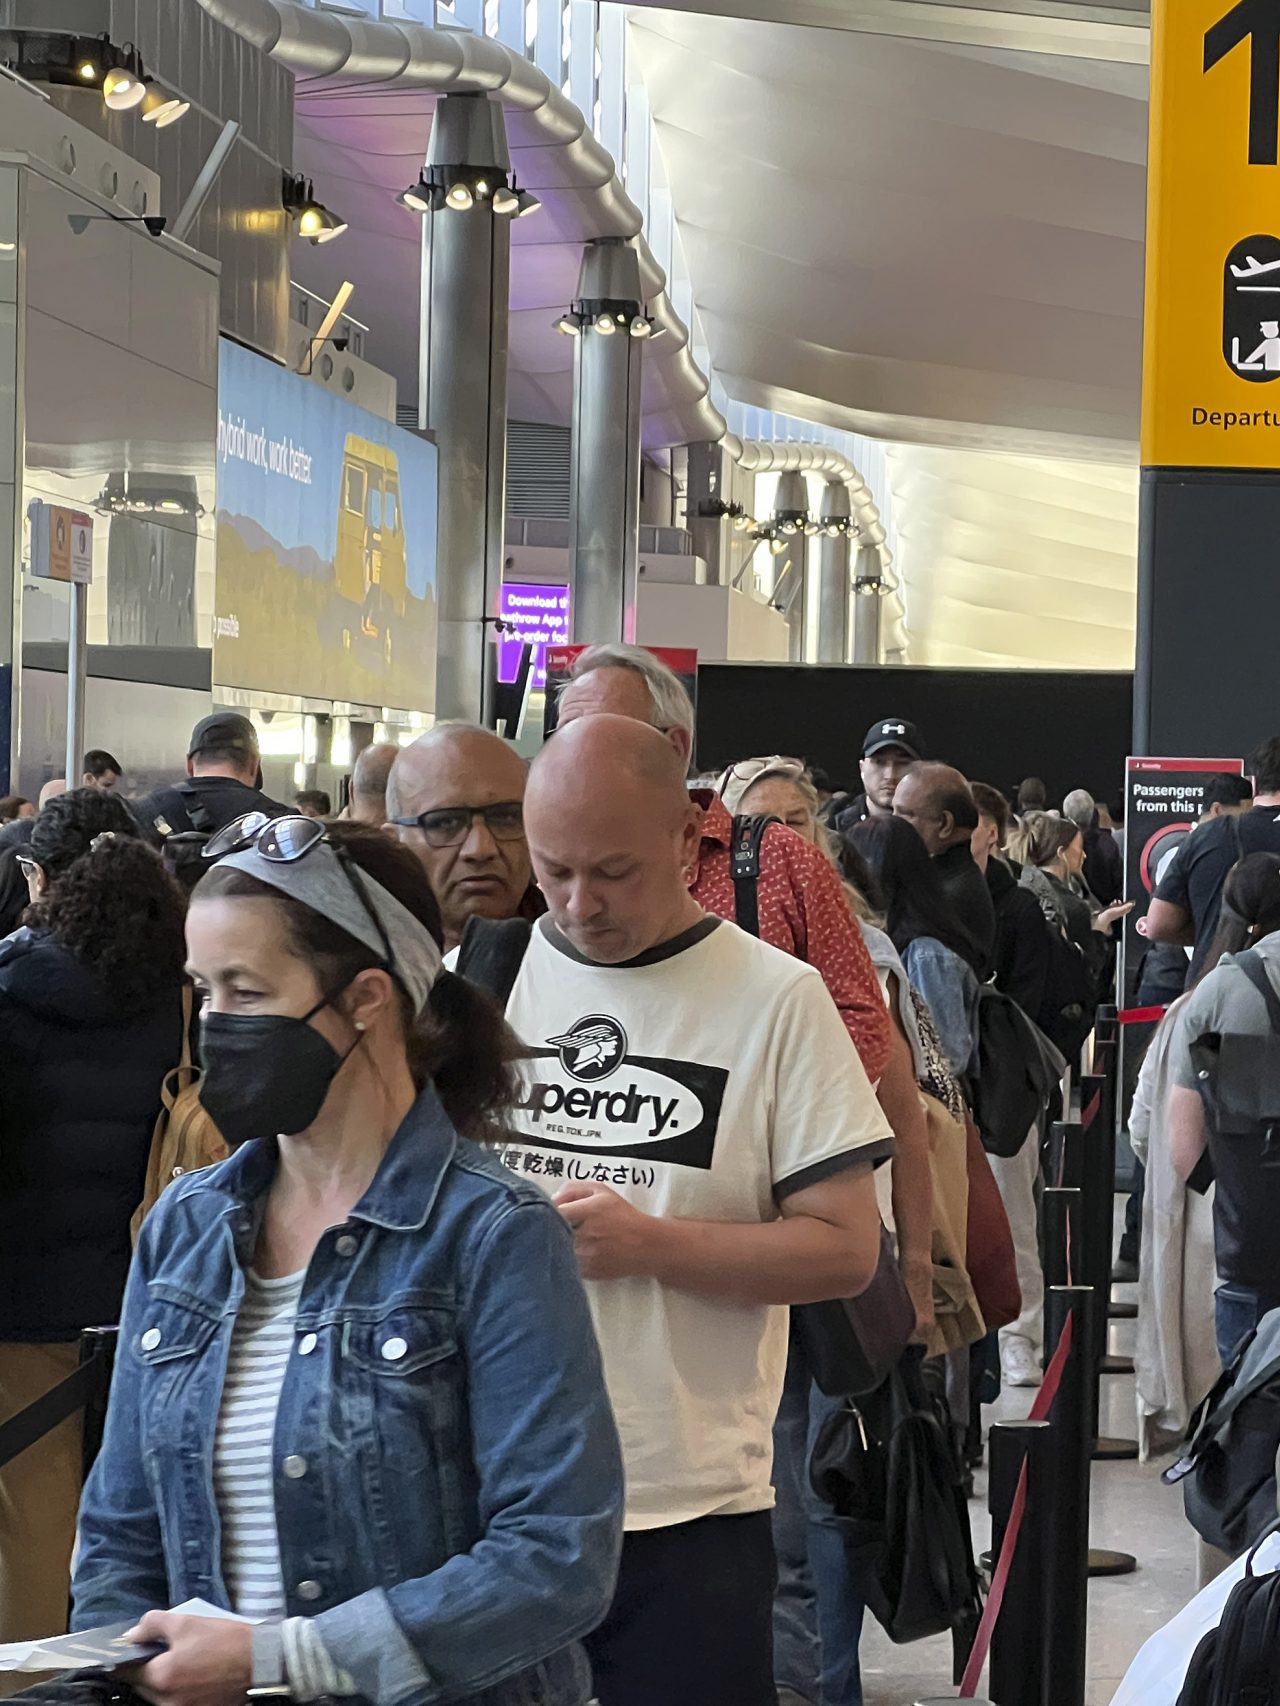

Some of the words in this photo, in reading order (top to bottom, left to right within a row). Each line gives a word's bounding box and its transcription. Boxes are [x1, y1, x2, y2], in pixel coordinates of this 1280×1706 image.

[246, 427, 268, 475] work,
[269, 435, 289, 476] work
[508, 594, 557, 608] Download
[559, 597, 568, 609] th
[500, 611, 541, 624] eathrow
[542, 613, 564, 628] App
[1133, 783, 1204, 799] Passengers
[1136, 799, 1168, 812] from
[1170, 800, 1195, 813] this
[512, 1083, 680, 1137] uperdry.
